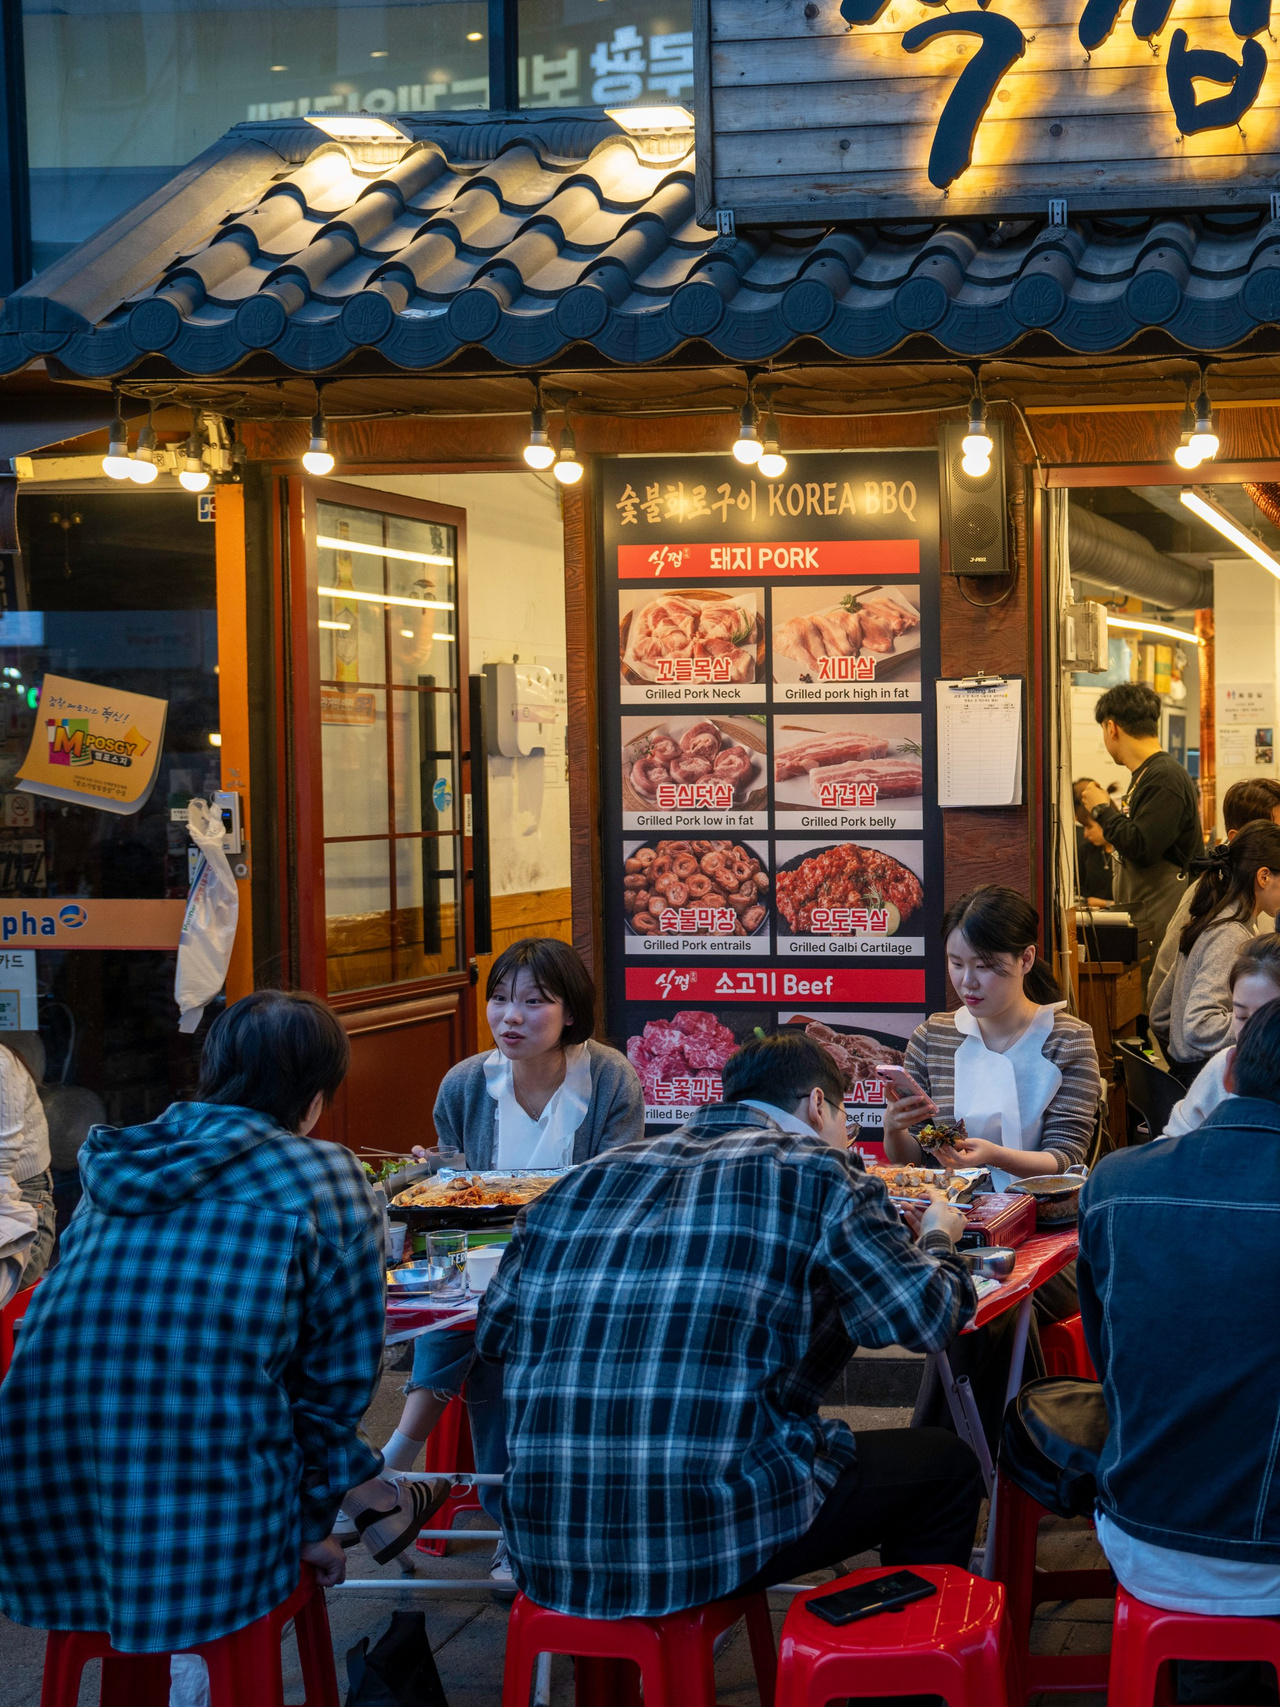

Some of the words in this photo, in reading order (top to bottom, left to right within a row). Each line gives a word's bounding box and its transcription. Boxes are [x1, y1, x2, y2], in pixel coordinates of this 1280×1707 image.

[616, 480, 757, 525] 숯불화로구이
[768, 482, 856, 517] KOREA
[864, 480, 917, 522] BBQ
[709, 546, 752, 571] 돼지
[758, 547, 819, 569] PORK
[656, 657, 731, 682] 꼬들목살
[819, 656, 877, 681] 치마살
[645, 688, 682, 699] Grilled
[684, 688, 710, 699] Pork
[712, 688, 741, 699] Neck
[785, 688, 822, 699] Grilled
[824, 688, 851, 703] pork
[853, 687, 878, 703] high
[881, 688, 891, 699] in
[893, 687, 910, 699] fat
[94, 752, 128, 766] 엠포스지
[819, 784, 877, 808] 삼겹살
[637, 815, 673, 825] Grilled
[675, 815, 701, 825] Pork
[703, 815, 723, 825] low
[725, 815, 736, 825] in
[738, 815, 754, 825] fat
[801, 816, 838, 826] Grilled
[841, 816, 866, 826] Pork
[869, 816, 896, 830] belly
[659, 908, 736, 932] 숯불막창
[811, 908, 889, 933] 오도독살
[643, 940, 680, 951] Grilled
[682, 940, 707, 951] Pork
[710, 940, 752, 951] entrails
[789, 942, 826, 953] Grilled
[828, 942, 858, 953] Galbi
[860, 942, 912, 956] Cartilage
[715, 972, 777, 996] 소고기
[783, 974, 834, 995] Beef
[654, 1078, 723, 1102] 눈꽃깍두
[845, 1080, 888, 1104] A갈
[646, 1109, 672, 1119] rilled
[675, 1109, 694, 1119] Be
[847, 1112, 864, 1122] eef
[867, 1112, 882, 1124] rip
